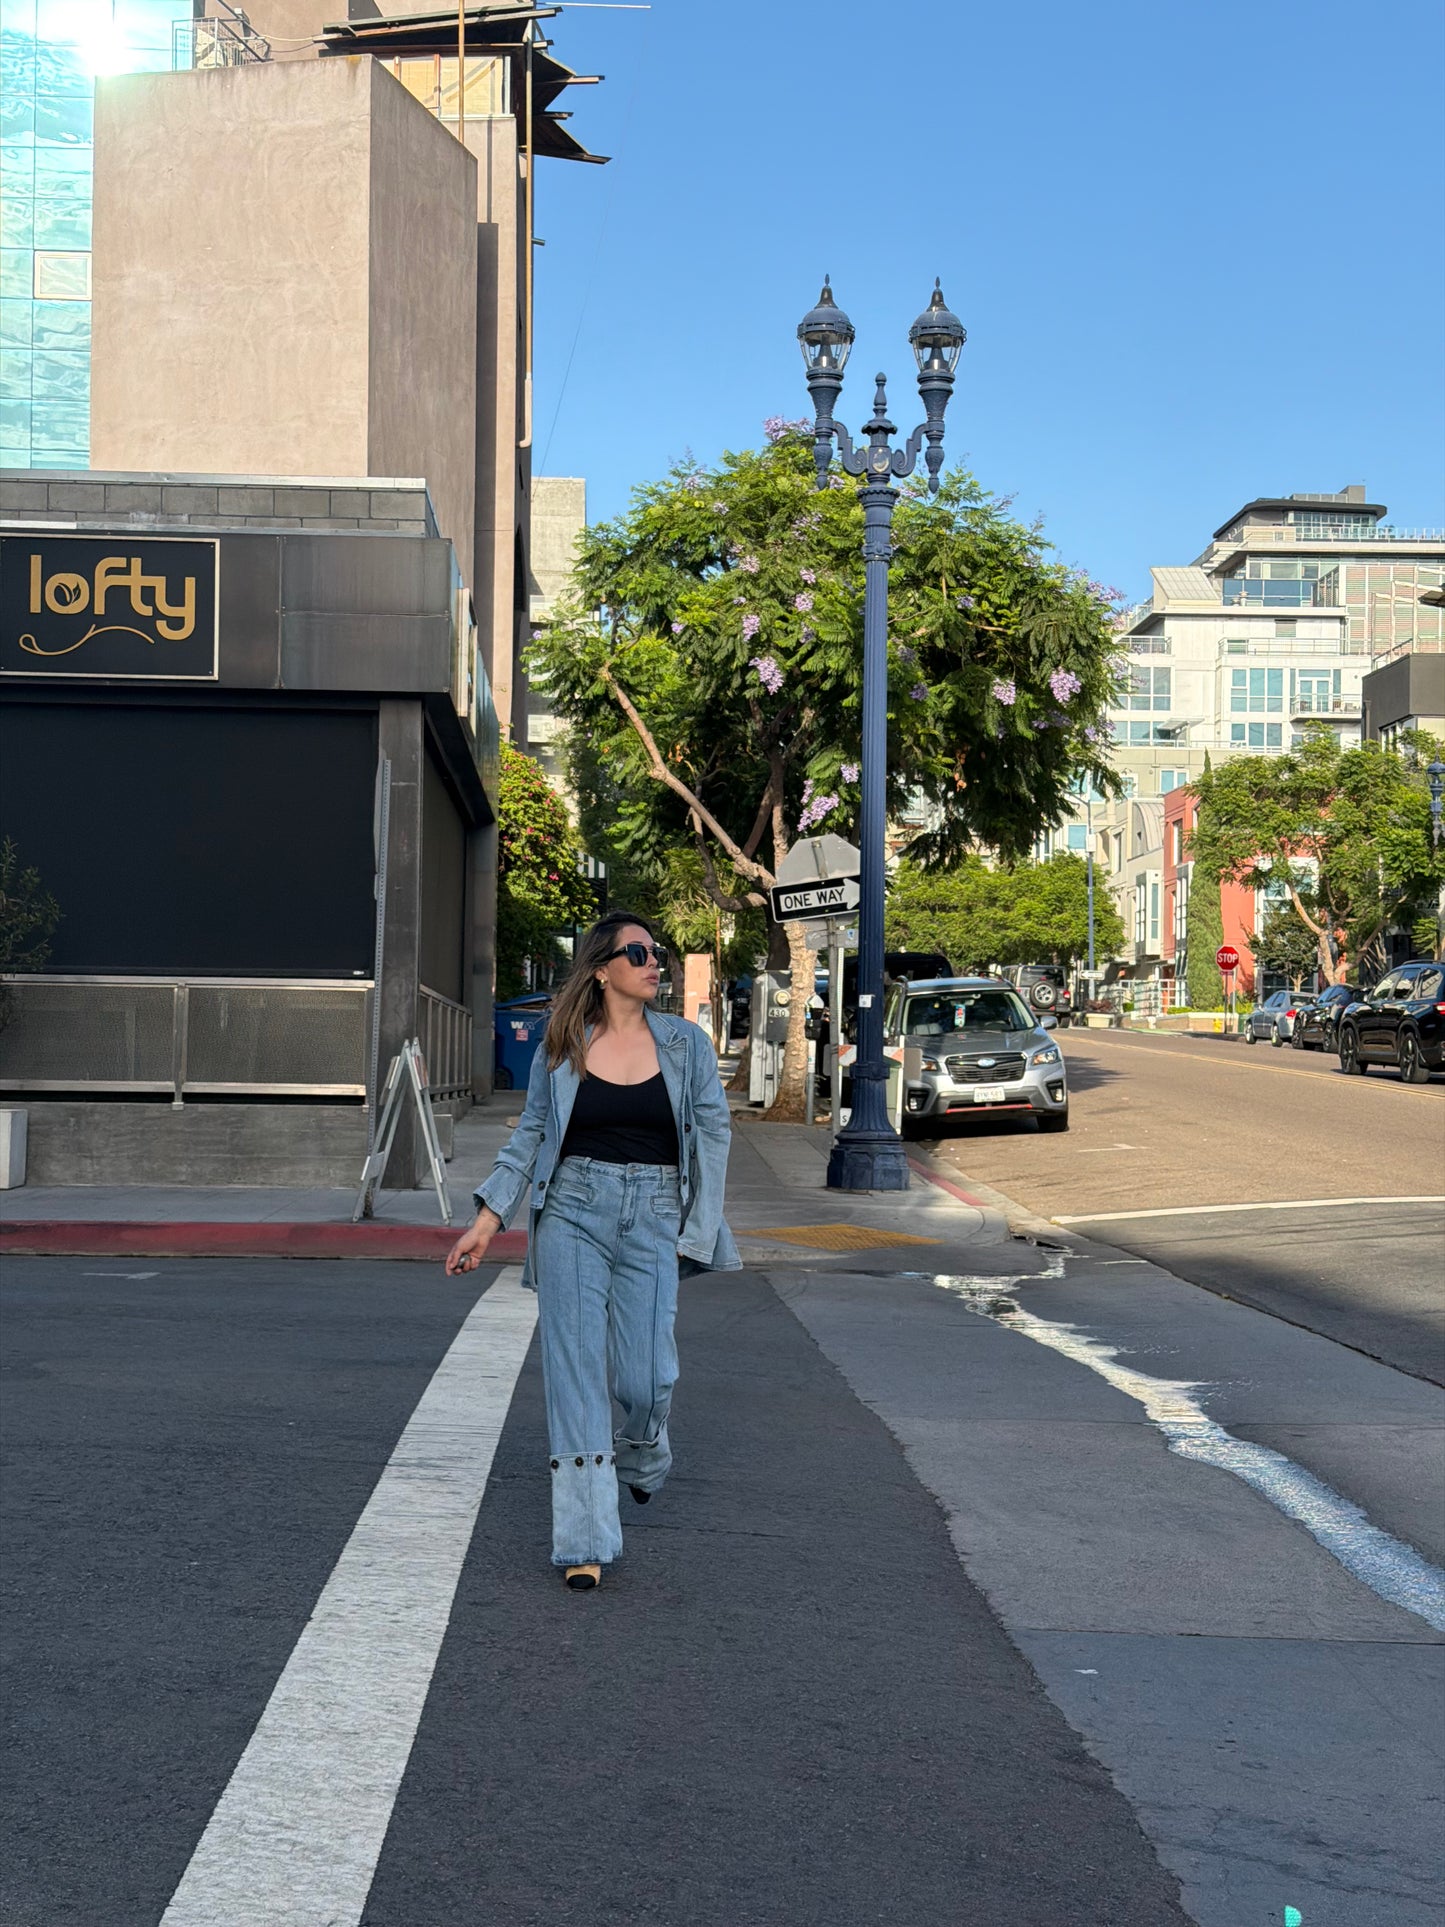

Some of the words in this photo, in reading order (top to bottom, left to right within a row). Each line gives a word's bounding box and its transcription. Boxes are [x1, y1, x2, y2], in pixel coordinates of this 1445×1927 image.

[30, 554, 196, 641] lofty
[784, 893, 812, 909] ONE
[816, 888, 845, 904] WAY
[1217, 952, 1238, 963] STOP
